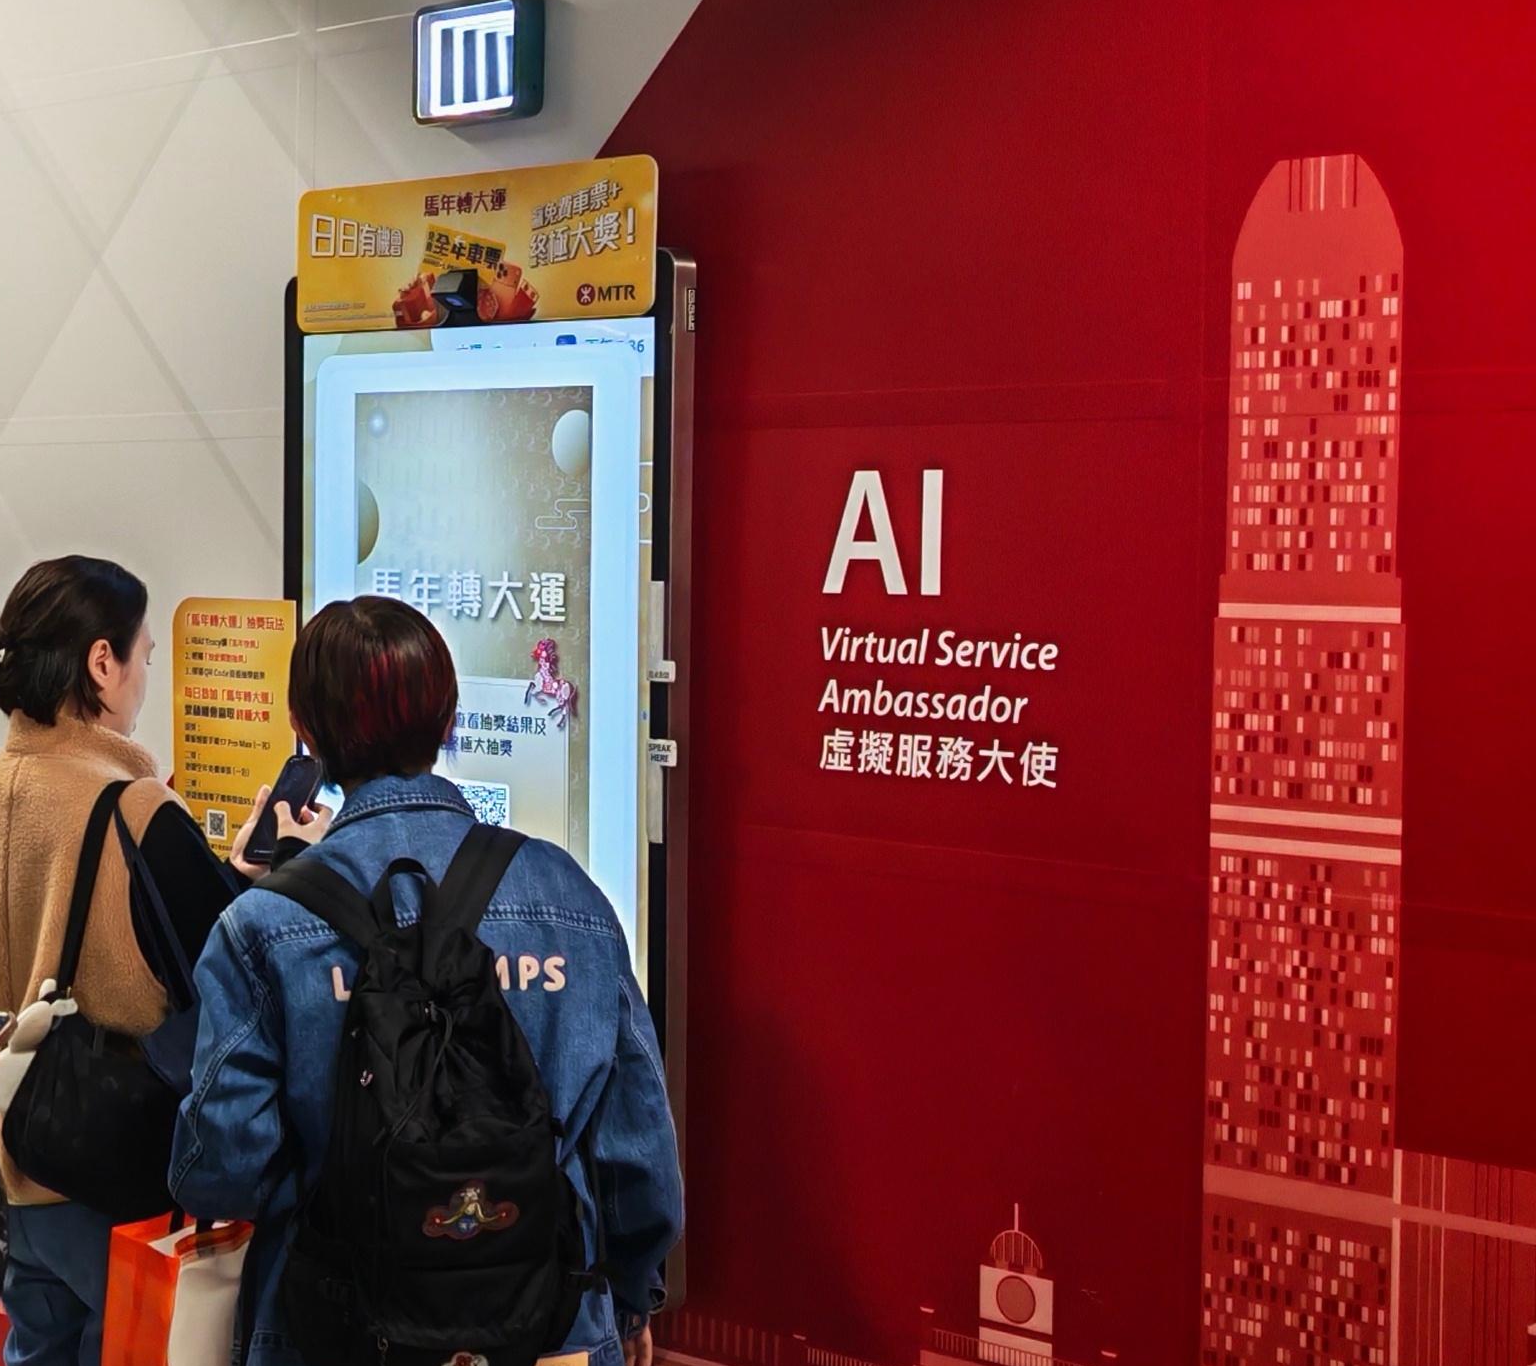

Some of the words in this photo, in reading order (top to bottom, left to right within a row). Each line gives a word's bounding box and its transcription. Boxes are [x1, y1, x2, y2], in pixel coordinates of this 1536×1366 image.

[424, 188, 507, 217] 馬年轉大運
[311, 213, 403, 258] 日日有機會
[597, 284, 636, 303] MTR
[822, 469, 943, 596] AI
[372, 568, 566, 622] 馬年轉大運
[821, 627, 929, 665] Virtual
[935, 630, 1058, 671] Service
[818, 679, 1028, 724] Ambassador
[648, 743, 671, 752] SPEAK
[650, 753, 669, 762] HERE
[819, 728, 1059, 788] 虛擬服務大使
